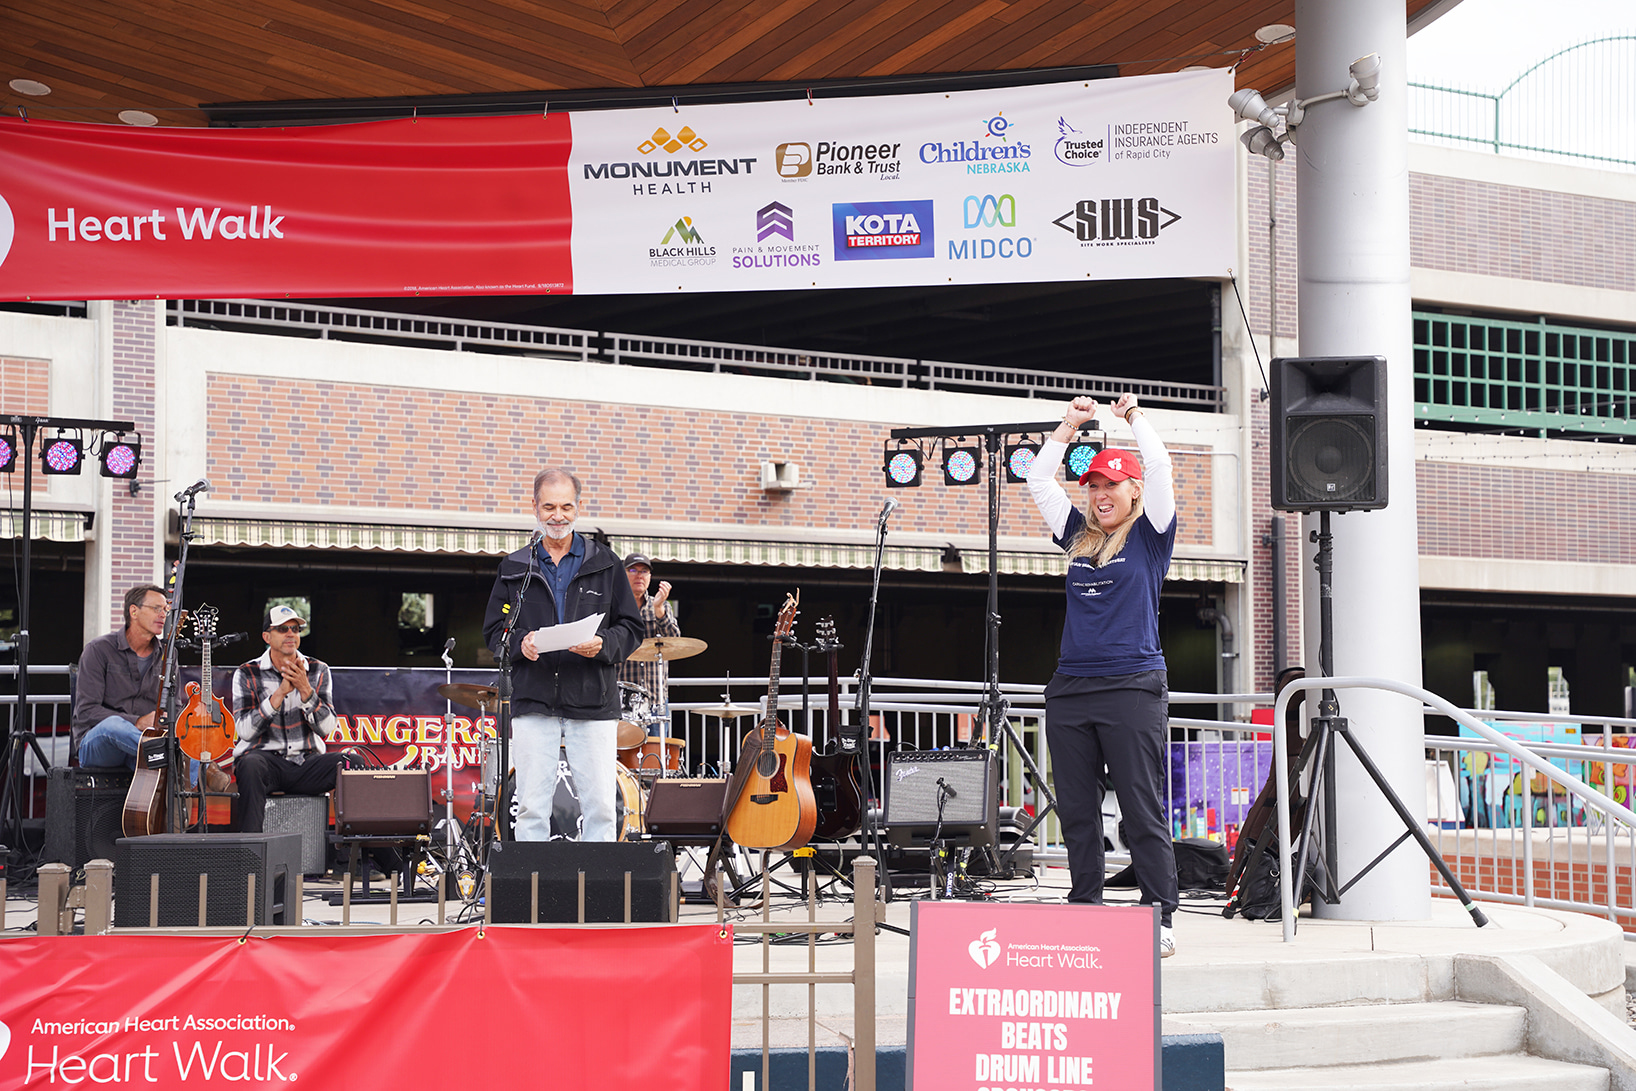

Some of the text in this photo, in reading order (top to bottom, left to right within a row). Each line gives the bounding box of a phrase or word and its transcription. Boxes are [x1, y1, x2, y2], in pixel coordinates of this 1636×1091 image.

[1114, 121, 1188, 135] INDEPENDENT
[1064, 139, 1103, 149] Trusted
[1114, 132, 1218, 148] INSURANCE AGENTS
[816, 141, 901, 162] Pioneer
[919, 141, 1031, 163] Children's
[1115, 149, 1171, 161] of Rapid City
[583, 158, 757, 179] MONUMENT
[817, 160, 901, 175] Bank & Trust
[967, 162, 1030, 175] NEBRASKA
[633, 181, 712, 195] HEALTH
[47, 205, 285, 242] Heart Walk
[845, 213, 921, 235] KOTA
[848, 234, 919, 246] TERRITORY
[649, 246, 717, 257] BLACK HILLS
[767, 244, 820, 253] MOVEMENT
[949, 237, 1032, 260] MIDCO
[650, 257, 717, 267] MEDICAL GROUP
[732, 253, 821, 269] SOLUTIONS
[327, 716, 497, 744] ANGERS
[421, 746, 487, 771] BAN
[895, 766, 921, 782] Fender
[1008, 942, 1040, 950] American
[1040, 943, 1060, 951] Heart
[1006, 951, 1053, 967] Heart
[949, 987, 1121, 1020] EXTRAORDINARY
[31, 1018, 119, 1035] American
[124, 1015, 180, 1032] Heart
[1001, 1021, 1068, 1051] BEATS
[24, 1045, 159, 1084] Heart
[975, 1053, 1093, 1085] DRUM LINE
